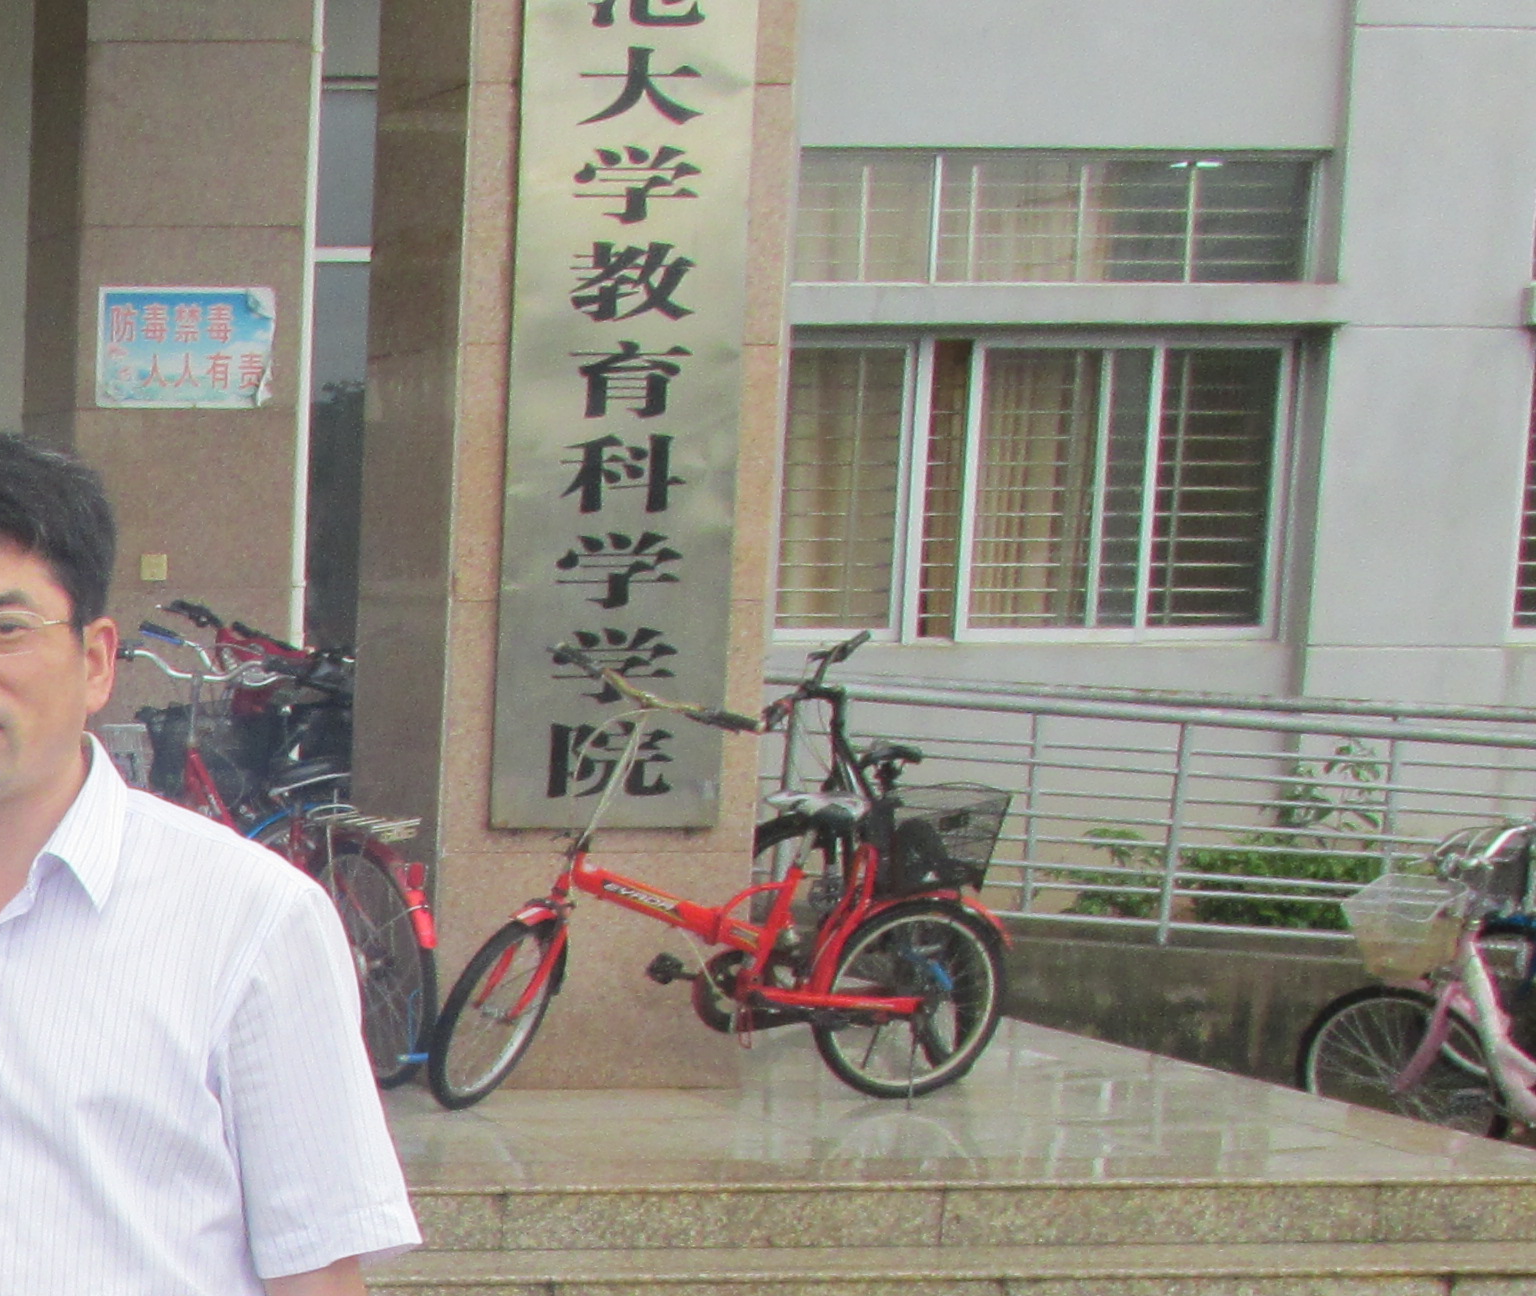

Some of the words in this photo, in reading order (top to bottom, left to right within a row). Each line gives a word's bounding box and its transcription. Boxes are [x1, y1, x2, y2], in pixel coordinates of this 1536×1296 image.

[109, 303, 234, 343] 防毒禁毒
[141, 352, 264, 390] 人人有责
